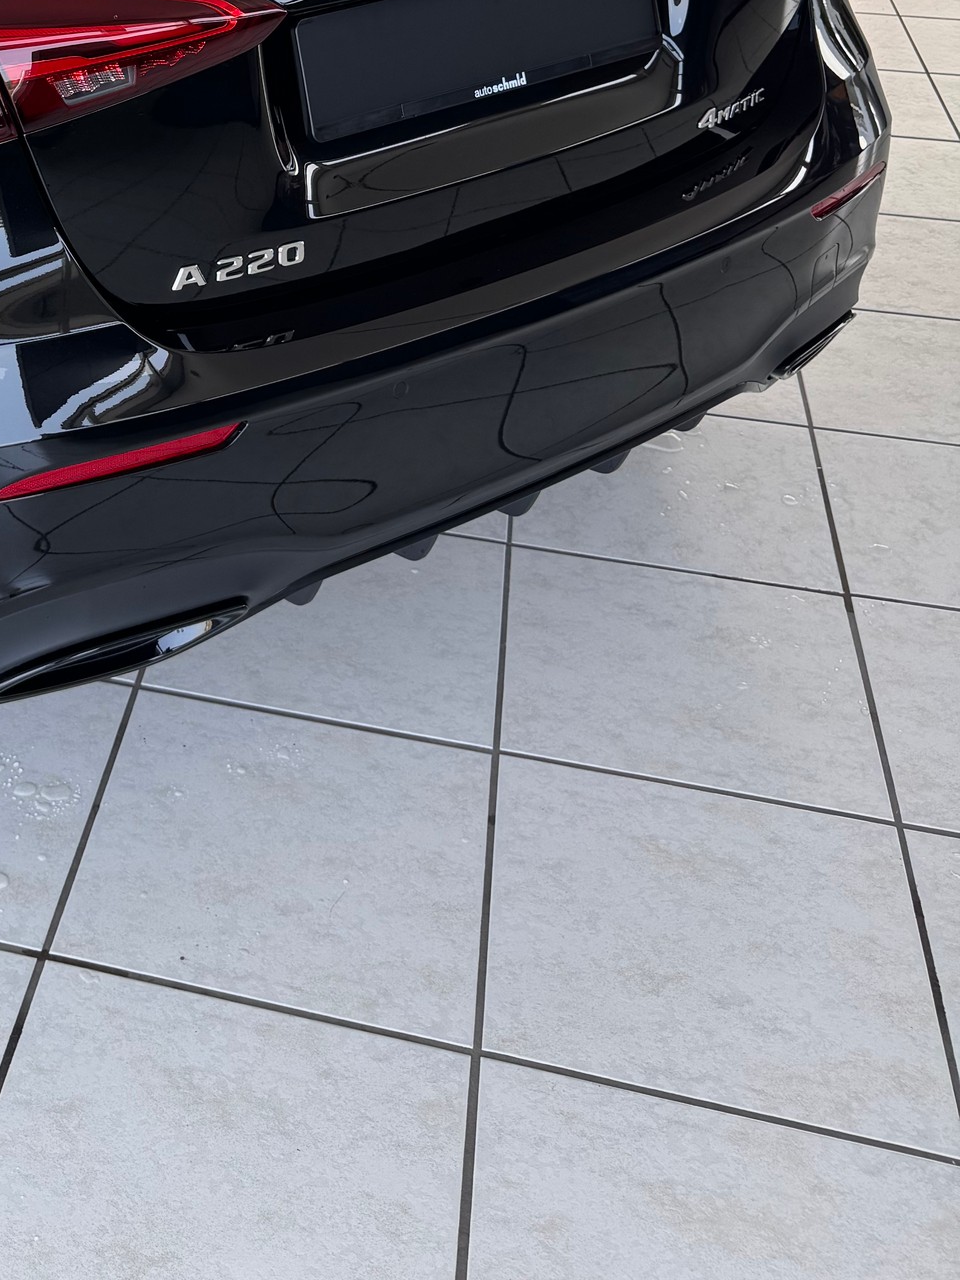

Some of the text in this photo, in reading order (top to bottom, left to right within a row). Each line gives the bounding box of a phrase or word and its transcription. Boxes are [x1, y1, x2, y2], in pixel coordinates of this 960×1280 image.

[697, 87, 765, 129] 4MATIC
[171, 240, 305, 291] A 220
